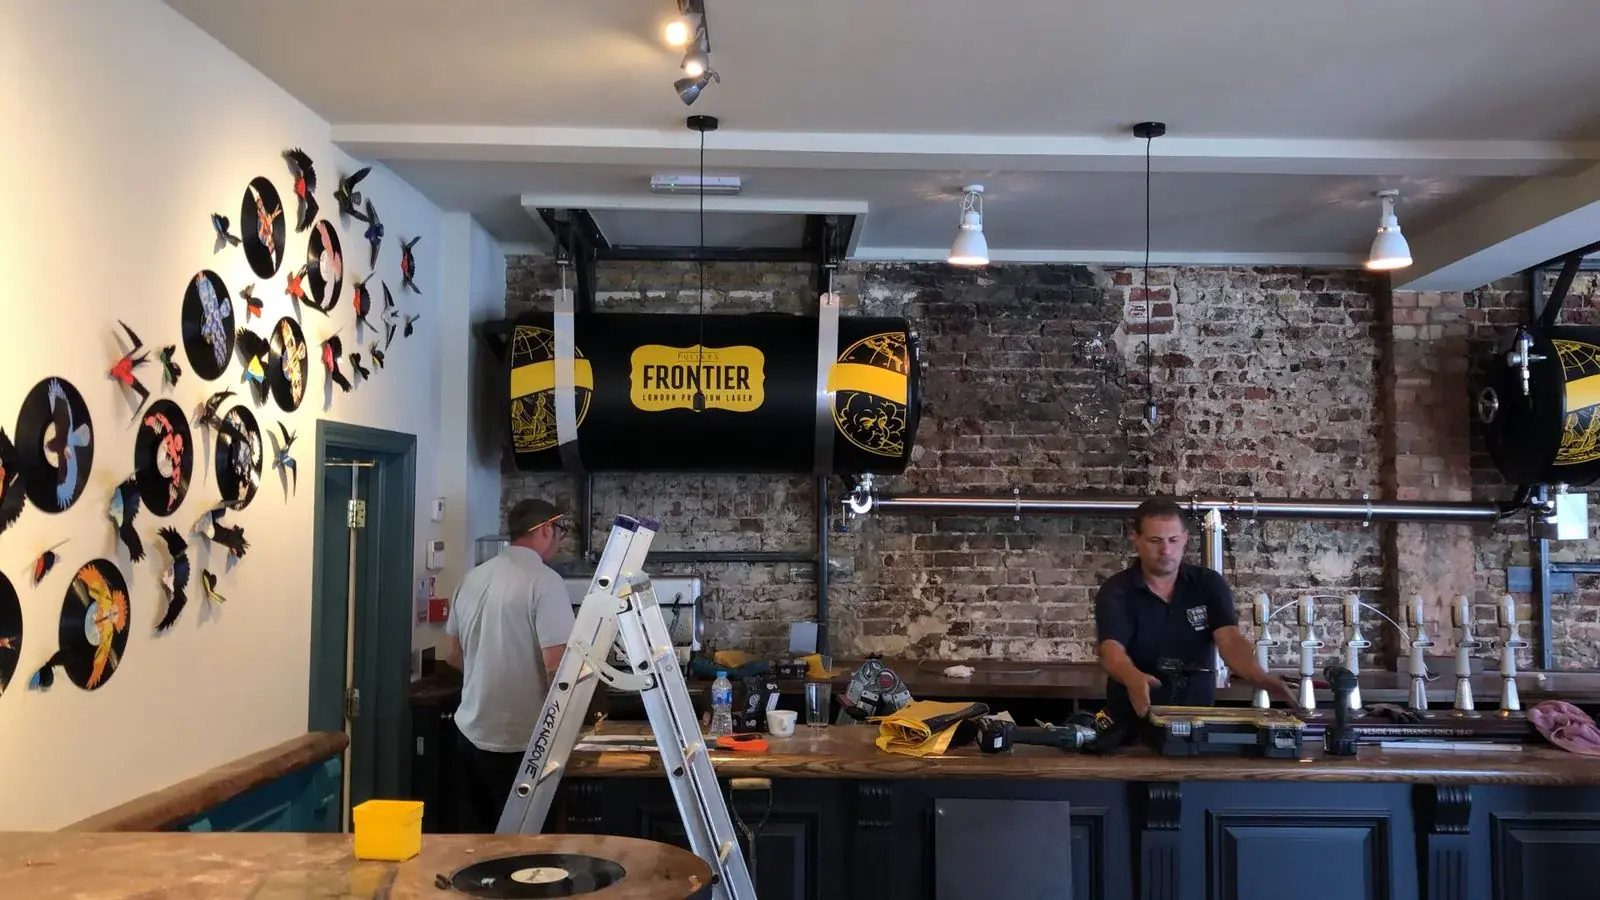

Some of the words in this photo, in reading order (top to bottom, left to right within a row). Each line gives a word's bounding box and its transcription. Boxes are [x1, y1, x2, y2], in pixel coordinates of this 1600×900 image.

[643, 365, 751, 390] FRONTIER
[642, 393, 677, 402] LONDON
[726, 393, 753, 402] LAGER
